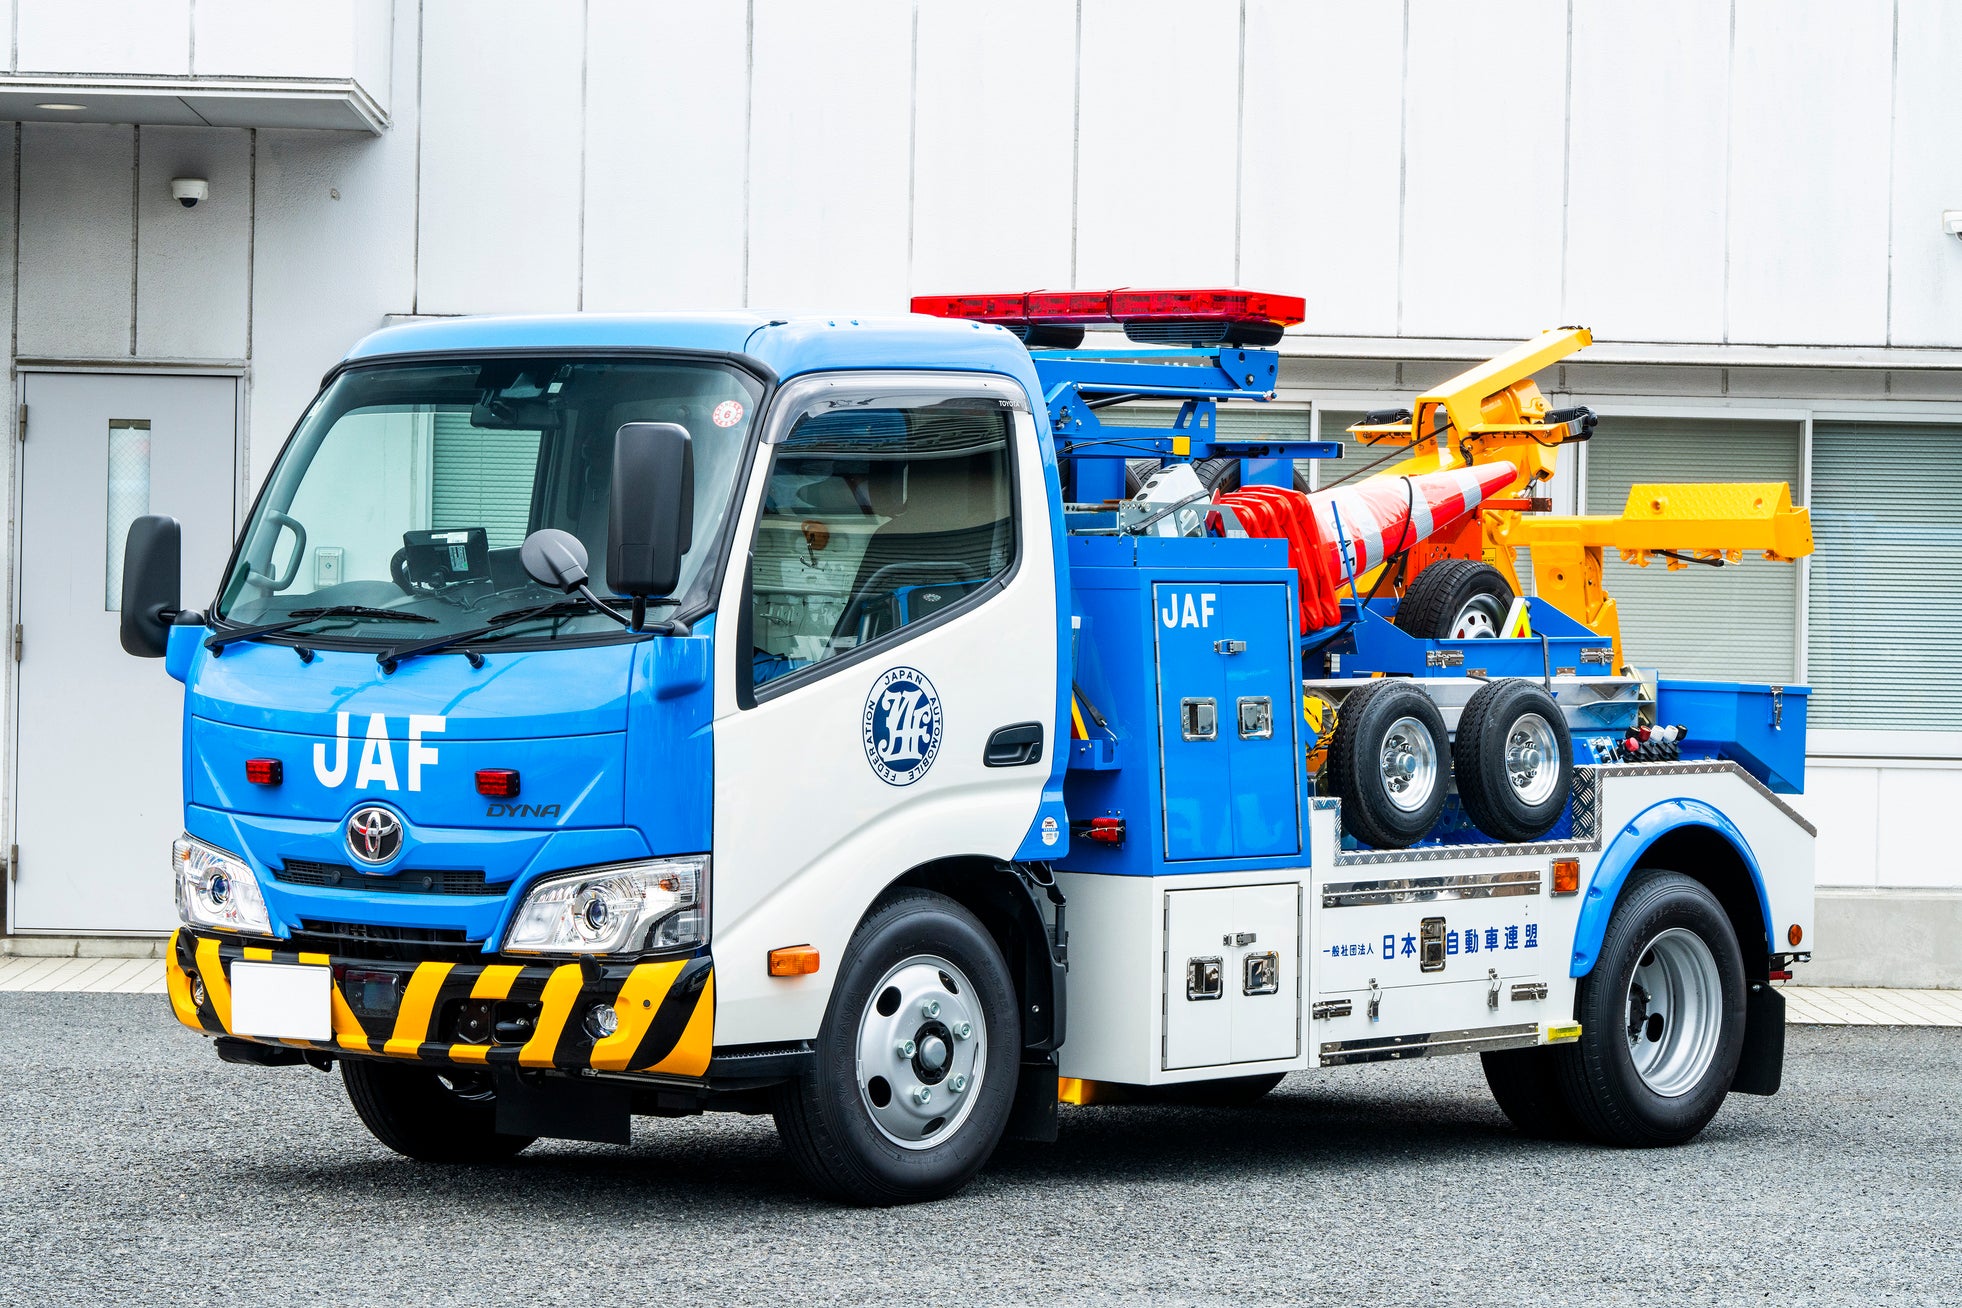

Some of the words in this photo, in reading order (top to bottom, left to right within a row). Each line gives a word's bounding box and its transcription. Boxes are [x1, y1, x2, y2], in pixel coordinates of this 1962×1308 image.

[723, 410, 731, 419] 6
[1162, 593, 1216, 628] JAF
[885, 670, 923, 685] JAPAN
[313, 711, 447, 792] JAF
[865, 699, 897, 781] FEDERATION
[908, 697, 941, 781] AUTOMOBILE
[486, 803, 561, 818] DYNA
[1322, 942, 1374, 957] 一般社団法人
